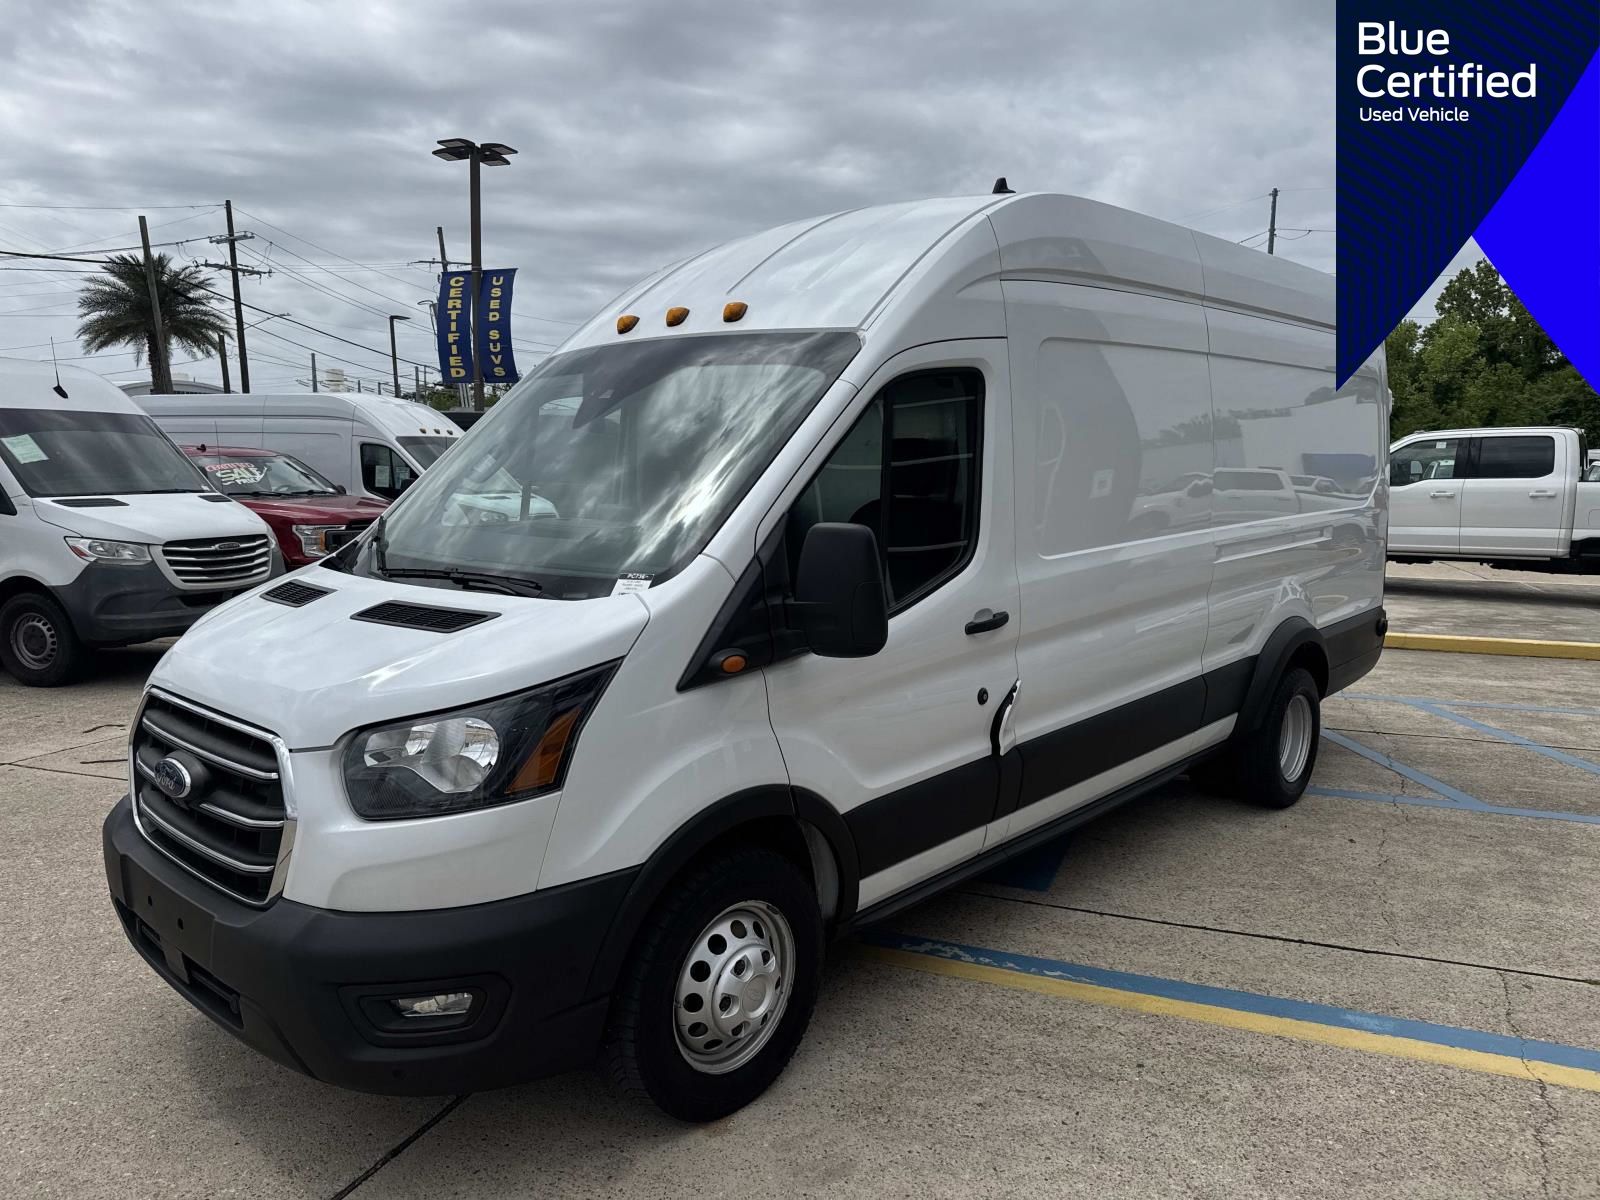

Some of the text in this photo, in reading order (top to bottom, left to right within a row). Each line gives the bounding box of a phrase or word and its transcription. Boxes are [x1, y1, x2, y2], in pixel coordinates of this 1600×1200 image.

[447, 276, 466, 378] CERTIFIED
[488, 276, 506, 377] USED SUVS
